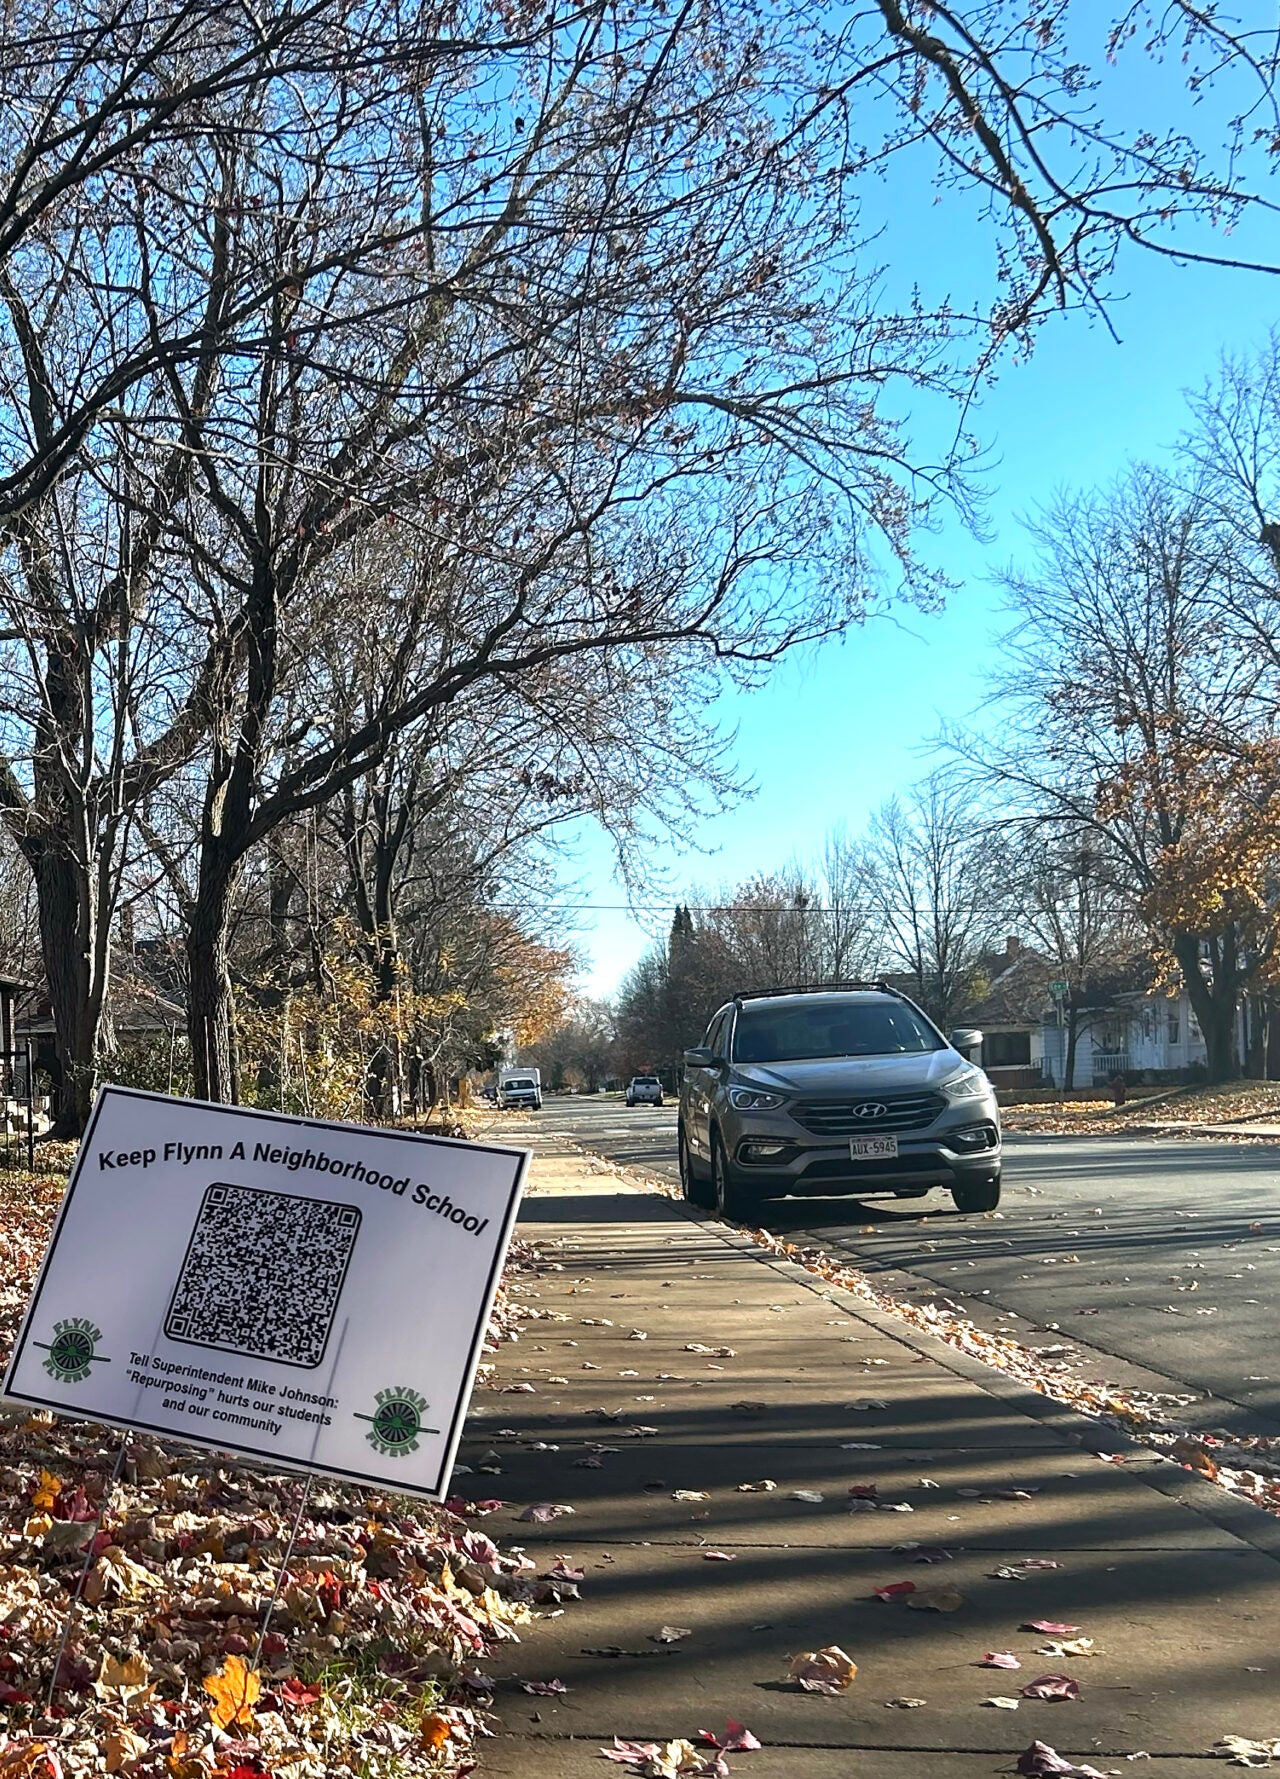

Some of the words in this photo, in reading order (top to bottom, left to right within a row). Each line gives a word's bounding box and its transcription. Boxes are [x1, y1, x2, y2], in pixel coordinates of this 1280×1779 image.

[852, 1141, 896, 1155] AUX-5945
[98, 1148, 156, 1171] Keep
[163, 1142, 223, 1165] Flynn
[229, 1142, 246, 1161] A
[253, 1142, 411, 1197] Neighborhood
[411, 1184, 489, 1237] School
[52, 1317, 103, 1342] FLYNN
[129, 1352, 150, 1368] Tell
[151, 1357, 250, 1389] Superintendent
[246, 1377, 277, 1396] Mike
[279, 1386, 340, 1409] Johnson:
[373, 1385, 431, 1413] FLYNN
[161, 1397, 185, 1412] and
[187, 1403, 210, 1417] our
[212, 1408, 283, 1436] community
[217, 1390, 250, 1409] hurts
[252, 1400, 275, 1414] our
[277, 1405, 332, 1427] students
